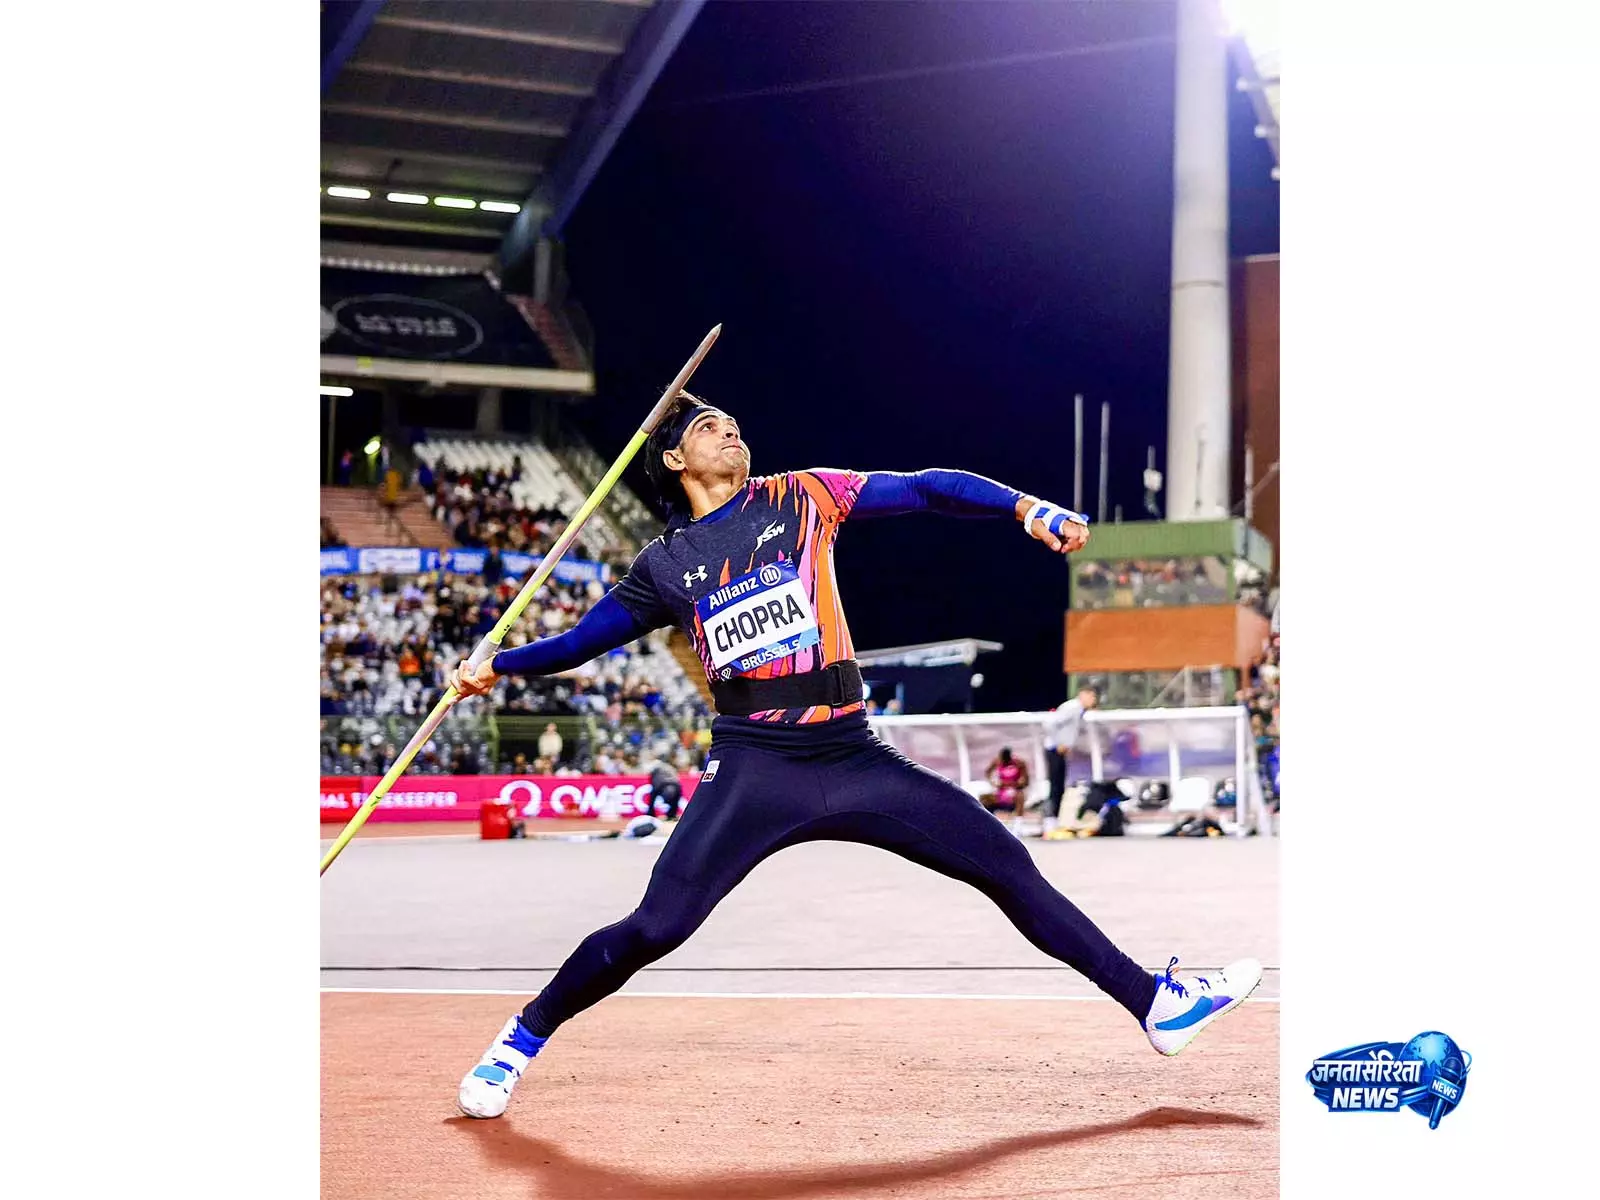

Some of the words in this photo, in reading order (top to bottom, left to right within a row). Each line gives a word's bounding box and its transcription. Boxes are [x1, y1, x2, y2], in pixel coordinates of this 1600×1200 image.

[754, 520, 785, 551] JSW
[709, 575, 760, 611] Allianz
[714, 593, 806, 653] CHOPRA
[741, 640, 802, 670] BRUSSELS
[351, 791, 458, 808] TIEKEEPER
